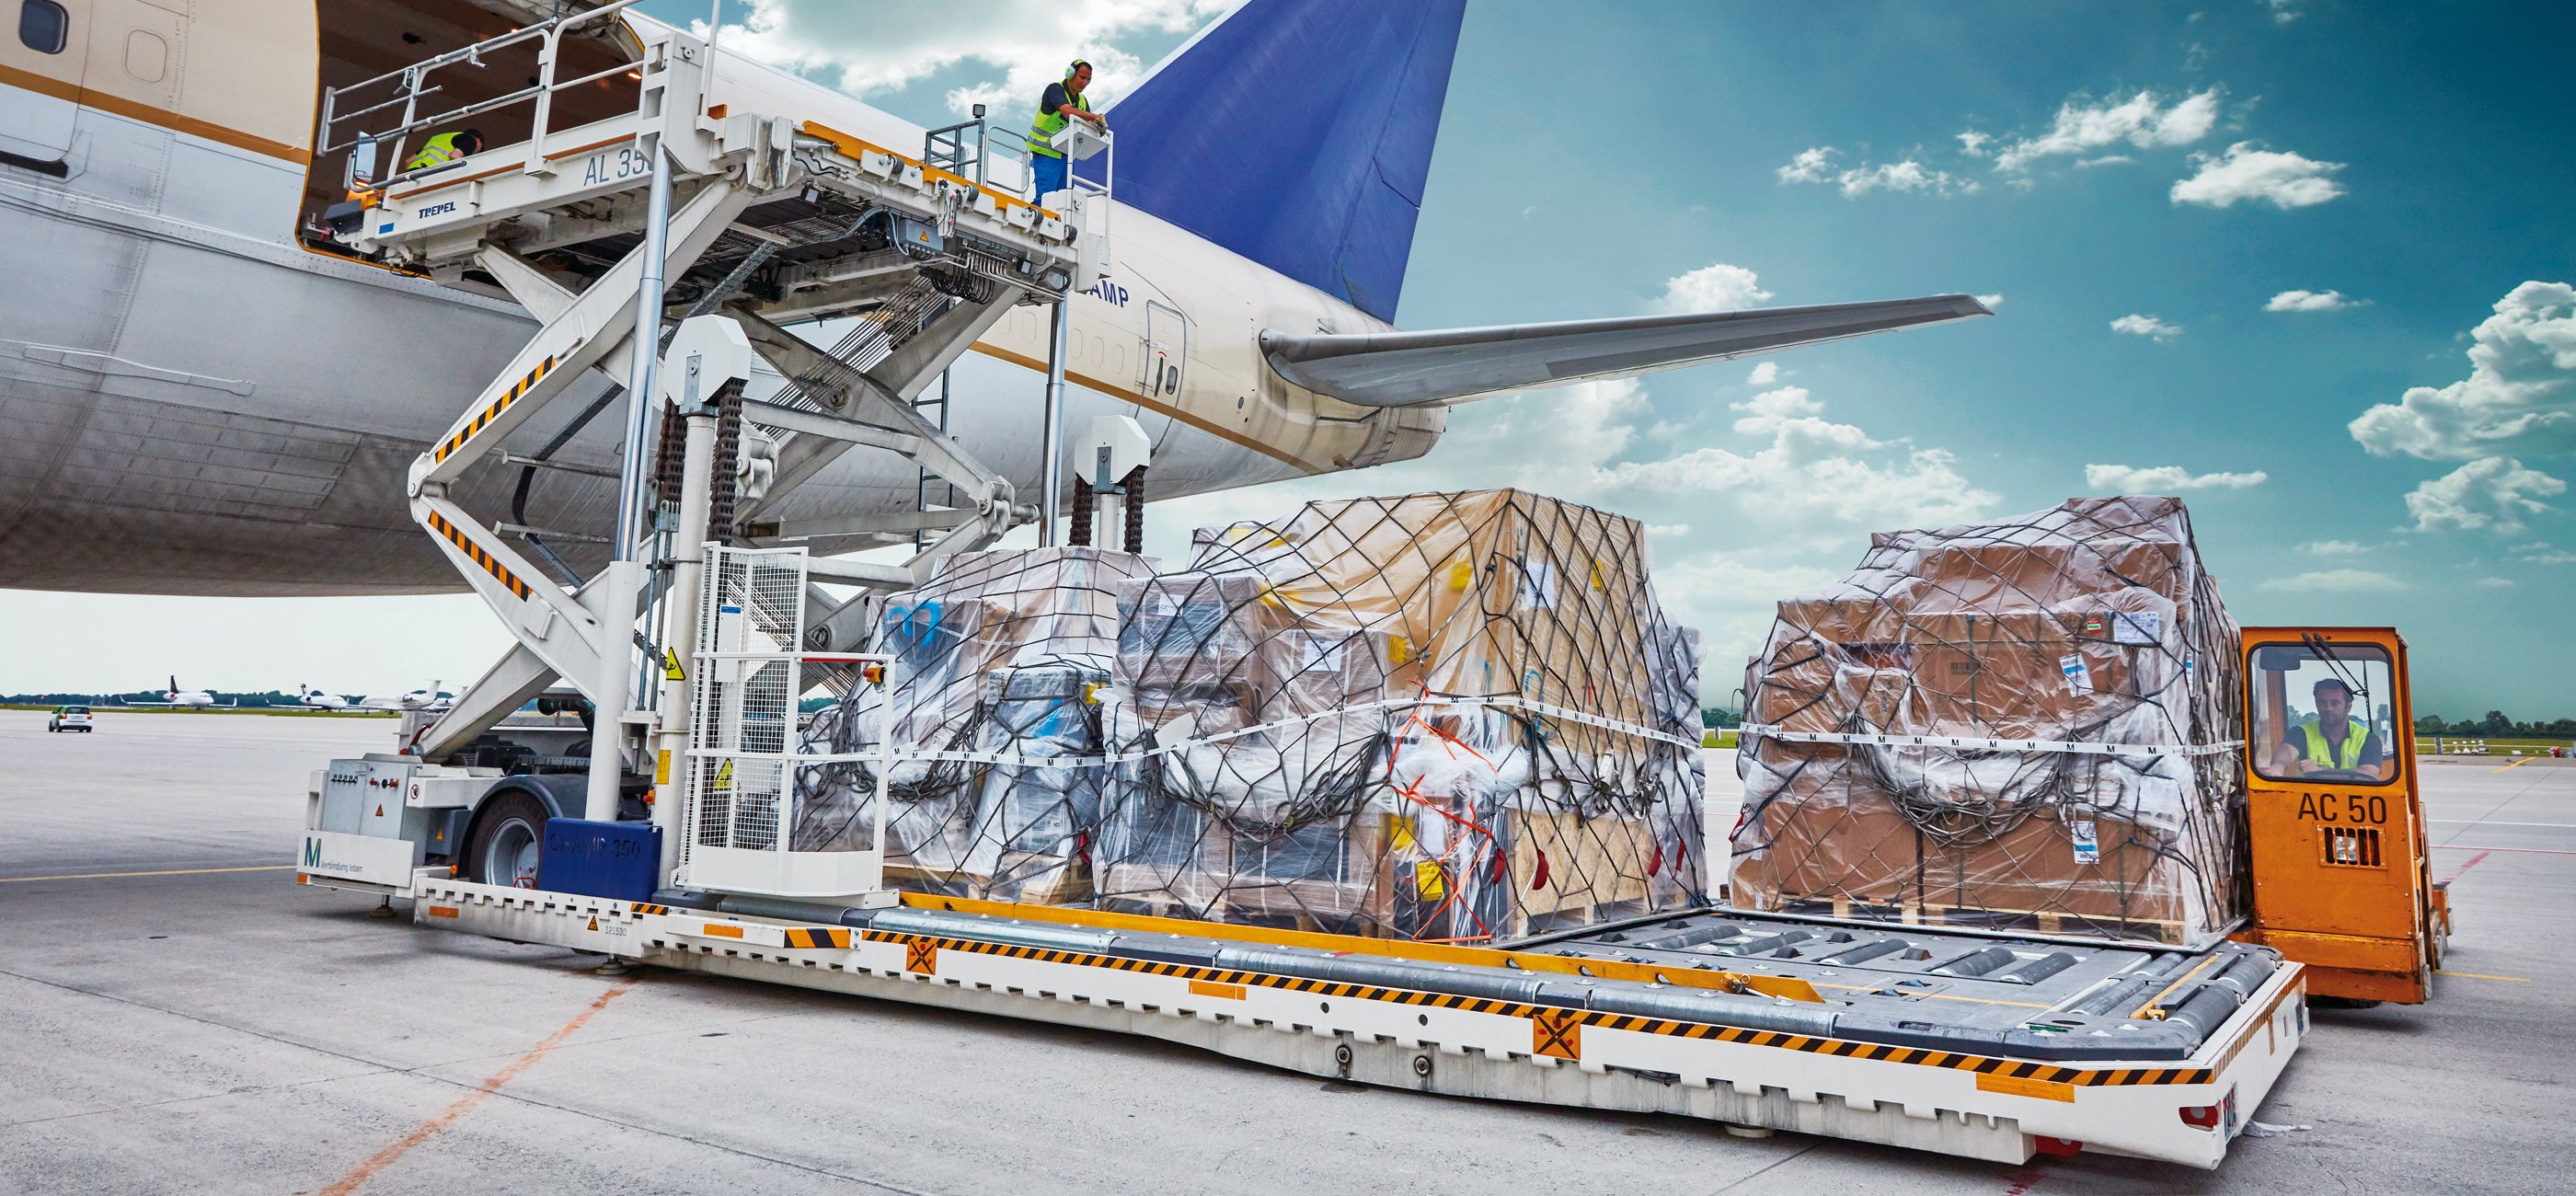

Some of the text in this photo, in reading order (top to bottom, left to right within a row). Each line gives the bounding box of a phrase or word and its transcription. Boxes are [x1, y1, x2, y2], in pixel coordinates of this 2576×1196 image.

[583, 155, 609, 187] AL
[419, 201, 456, 219] TREPEL
[2148, 746, 2156, 754] M
[2297, 792, 2387, 824] AC 50
[305, 836, 321, 868] M
[613, 839, 640, 858] 350
